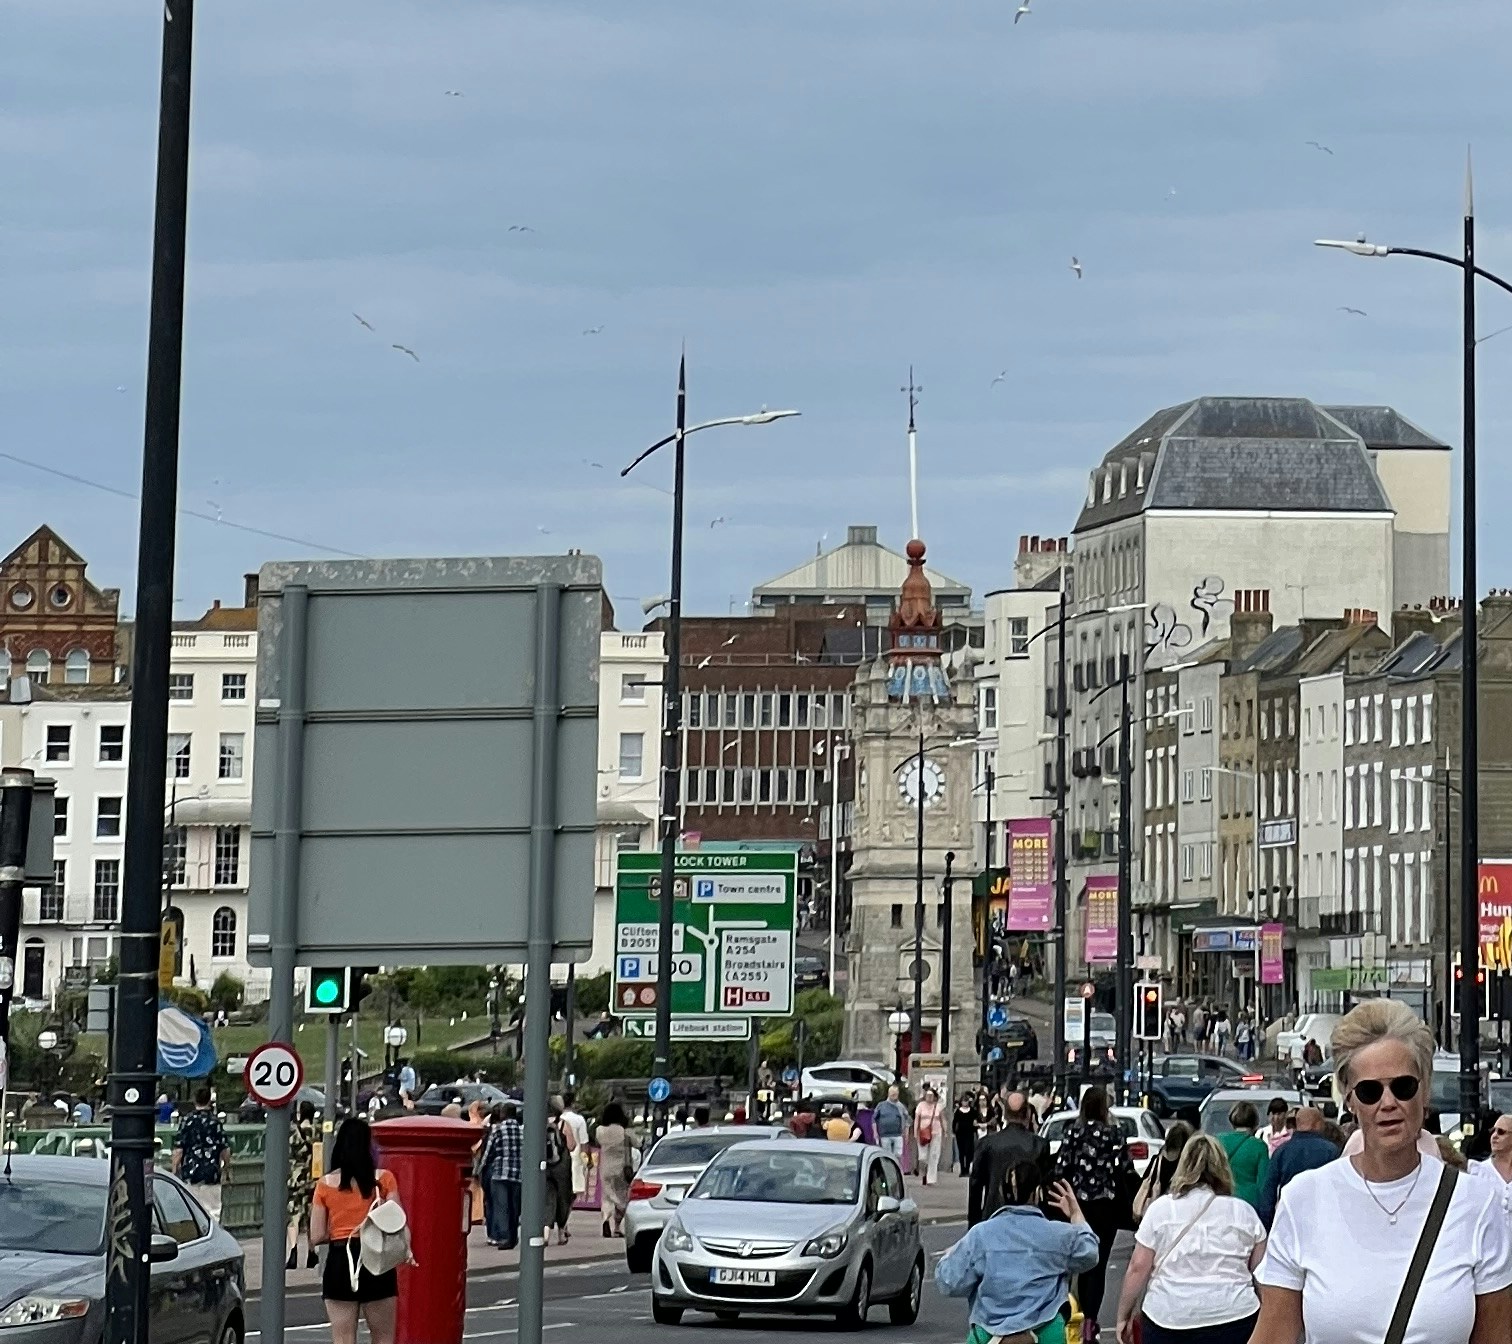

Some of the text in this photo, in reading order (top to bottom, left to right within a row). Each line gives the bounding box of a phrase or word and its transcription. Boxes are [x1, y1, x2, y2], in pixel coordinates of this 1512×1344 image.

[1012, 838, 1048, 849] MORE
[674, 856, 747, 867] LOCK TOWER
[718, 884, 745, 894] Town
[747, 885, 781, 894] centre
[621, 926, 680, 937] Cliftone
[726, 935, 777, 945] Ramsgate
[726, 946, 756, 955] A254
[725, 960, 785, 969] Broadstairs
[255, 1061, 295, 1086] 20
